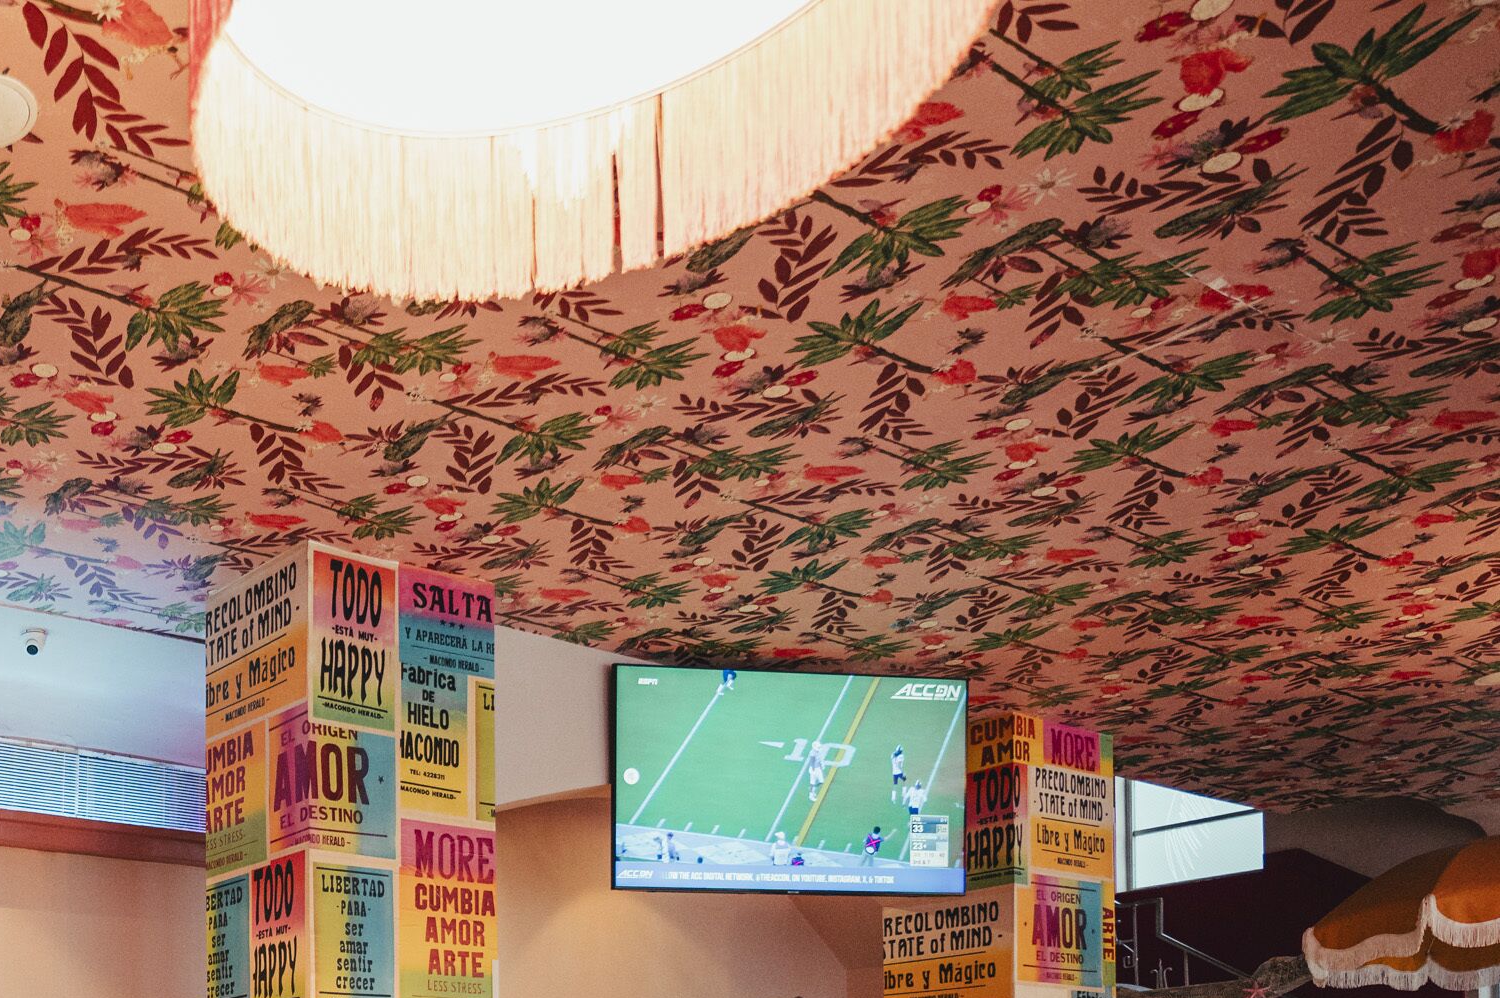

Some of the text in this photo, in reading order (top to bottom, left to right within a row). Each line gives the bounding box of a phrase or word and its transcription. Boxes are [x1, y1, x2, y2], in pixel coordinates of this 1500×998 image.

[330, 559, 382, 628] TODO
[412, 582, 493, 623] SALTA
[242, 597, 292, 649] of MIND
[405, 627, 411, 639] Y
[471, 639, 484, 653] LA
[236, 645, 295, 699] y Mágico
[320, 636, 386, 707] HAPPY
[637, 677, 658, 686] ESPN
[422, 689, 435, 703] DE
[407, 701, 450, 730] HIELO
[970, 715, 1035, 746] CUMBIA
[280, 730, 295, 747] EL
[981, 738, 1030, 767] AMOR
[1051, 728, 1096, 772] MORE
[274, 740, 370, 813] AMOR
[973, 766, 1021, 815] TODO
[1035, 767, 1106, 800] PRECOLOMBINO
[280, 806, 363, 830] EL DESTINO
[1039, 792, 1103, 822] STATE of MIND
[912, 824, 924, 833] 33
[1036, 823, 1105, 855] Libre y Mágico
[414, 828, 494, 885] MORE
[966, 824, 1023, 873] HAPPY
[254, 860, 294, 926] TODO
[321, 874, 385, 898] LIBERTAD
[414, 883, 495, 917] CUMBIA
[1036, 887, 1082, 904] EL ORIGEN
[211, 932, 226, 948] ser
[345, 922, 364, 937] ser
[425, 916, 485, 948] AMOR
[930, 925, 993, 955] of MIND
[1031, 904, 1088, 950] AMOR
[1101, 906, 1115, 961] ARTE
[340, 939, 368, 955] amar
[1036, 950, 1084, 965] EL DESTINO
[336, 956, 374, 974] sentir
[428, 949, 485, 978] ARTE
[922, 970, 930, 990] y
[939, 960, 997, 986] Mágico
[335, 974, 376, 991] crecer
[427, 979, 448, 993] LESS
